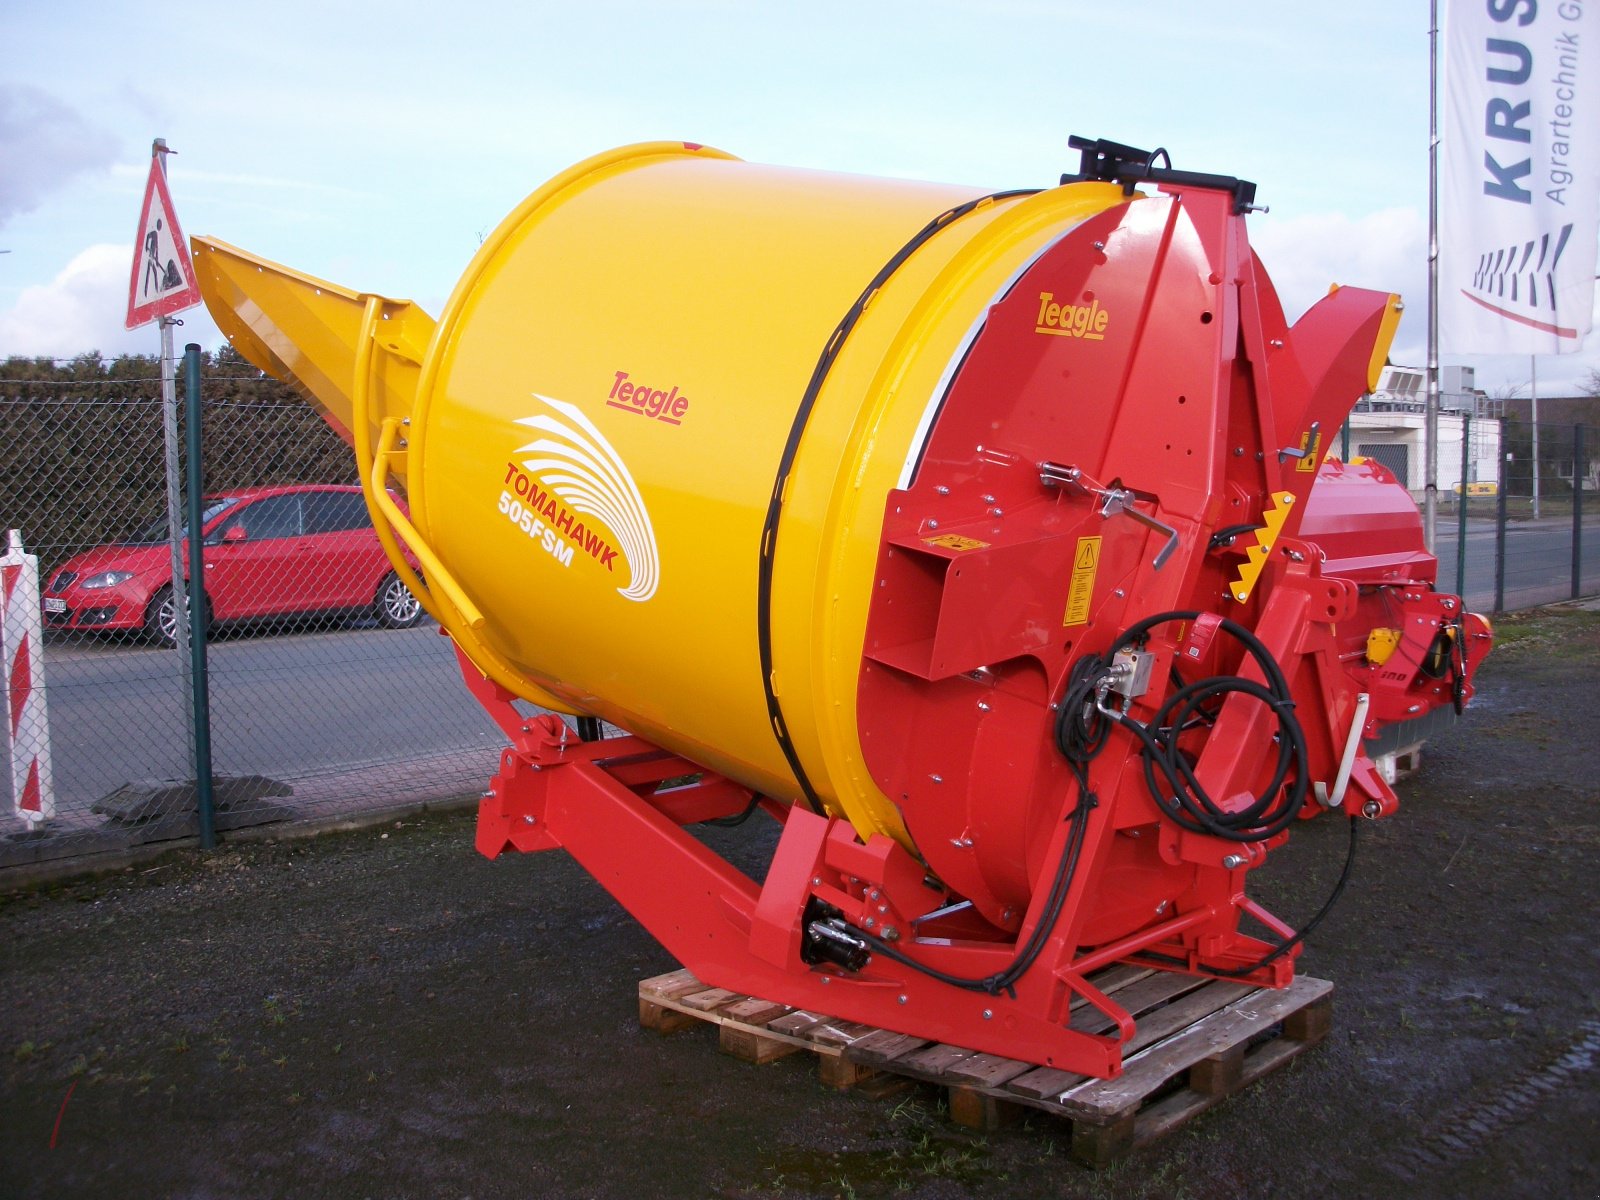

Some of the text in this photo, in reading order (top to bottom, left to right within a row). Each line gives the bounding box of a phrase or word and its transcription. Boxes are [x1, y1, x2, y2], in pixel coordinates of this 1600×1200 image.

[1483, 0, 1537, 204] KRUS
[1546, 0, 1583, 205] Agrartechnik G
[1036, 292, 1108, 338] Teagle
[607, 371, 689, 420] Teagle
[498, 490, 575, 567] 505FSM
[503, 462, 618, 571] TOMAHAWK
